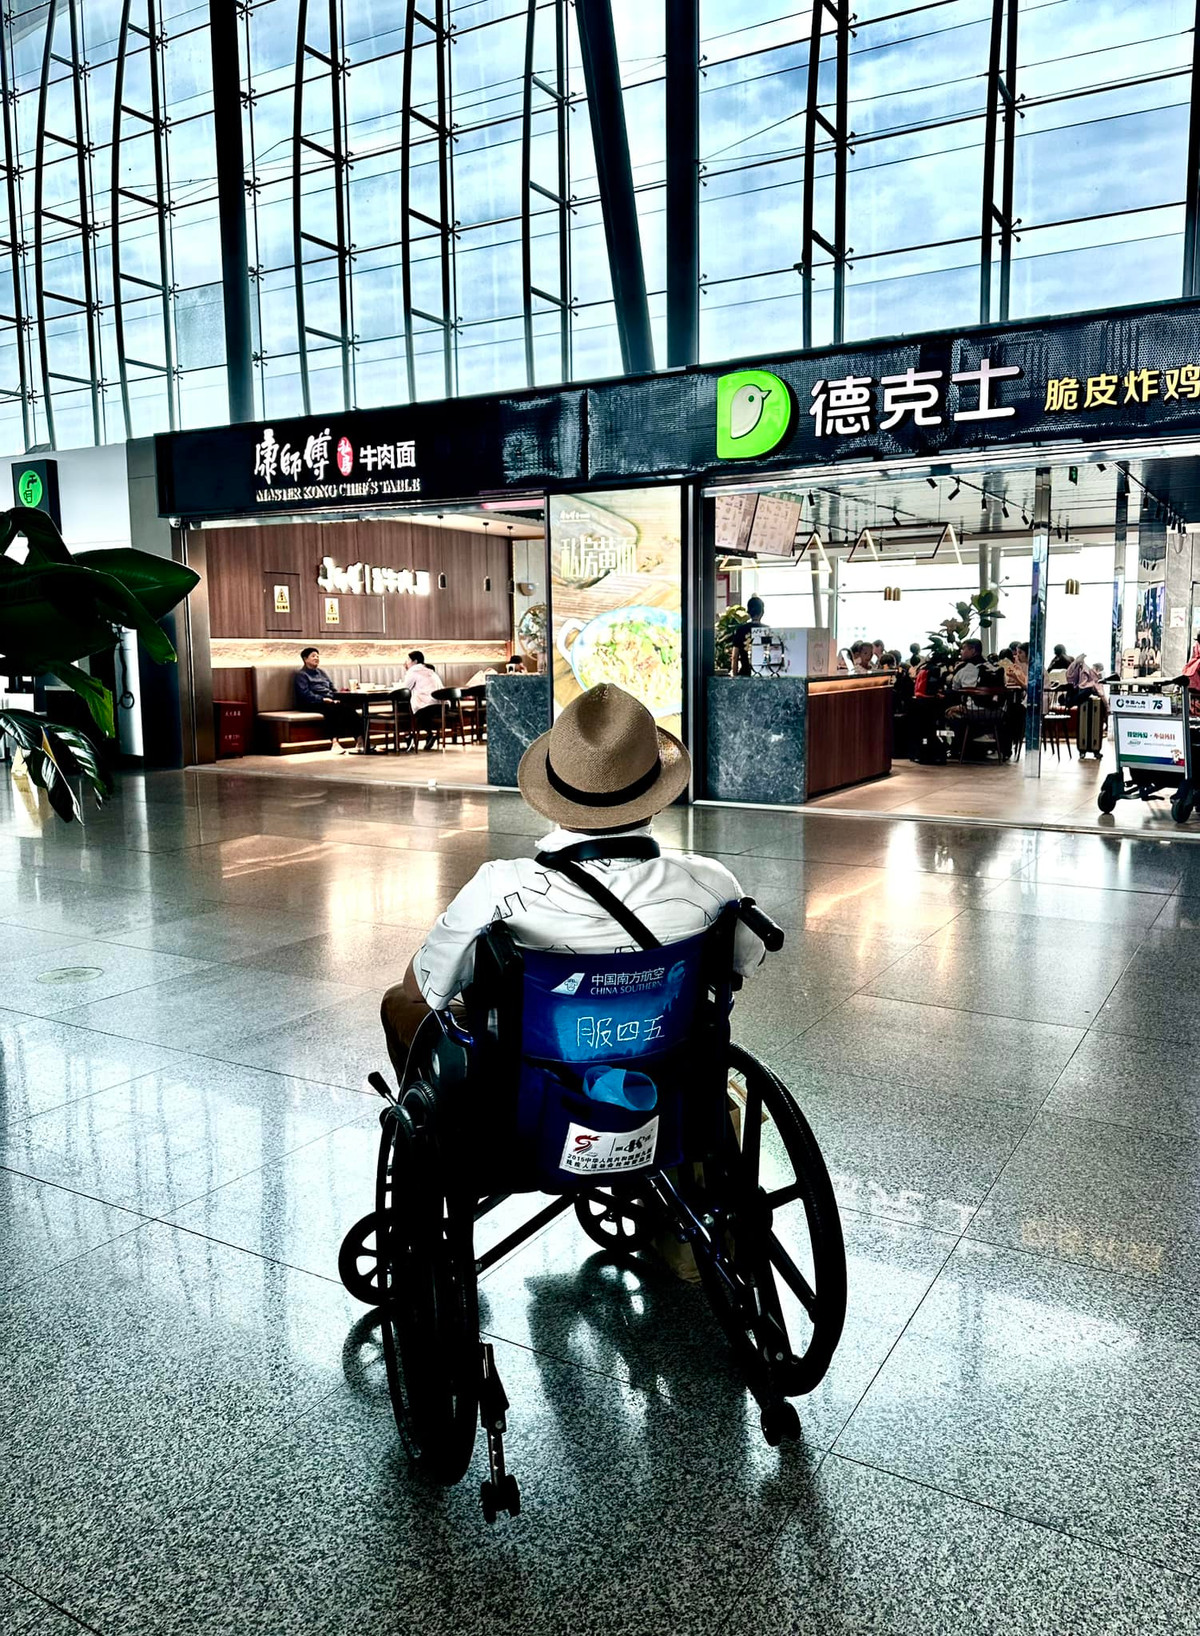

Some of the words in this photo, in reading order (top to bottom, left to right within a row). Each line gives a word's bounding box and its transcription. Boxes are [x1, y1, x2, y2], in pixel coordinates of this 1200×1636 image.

[809, 358, 1020, 436] 德克士
[1044, 363, 1200, 411] 脆皮炸鸡
[254, 428, 333, 484] 康師傅
[359, 440, 416, 471] 牛肉面
[256, 487, 302, 502] MASTER
[303, 485, 337, 499] KONG
[339, 478, 378, 496] CHEF'S
[379, 478, 421, 494] TABLE
[590, 987, 618, 995] CHINA
[620, 981, 663, 994] SOUTHERN
[591, 967, 665, 986] 中国南方航空
[576, 1014, 665, 1048] 服四五
